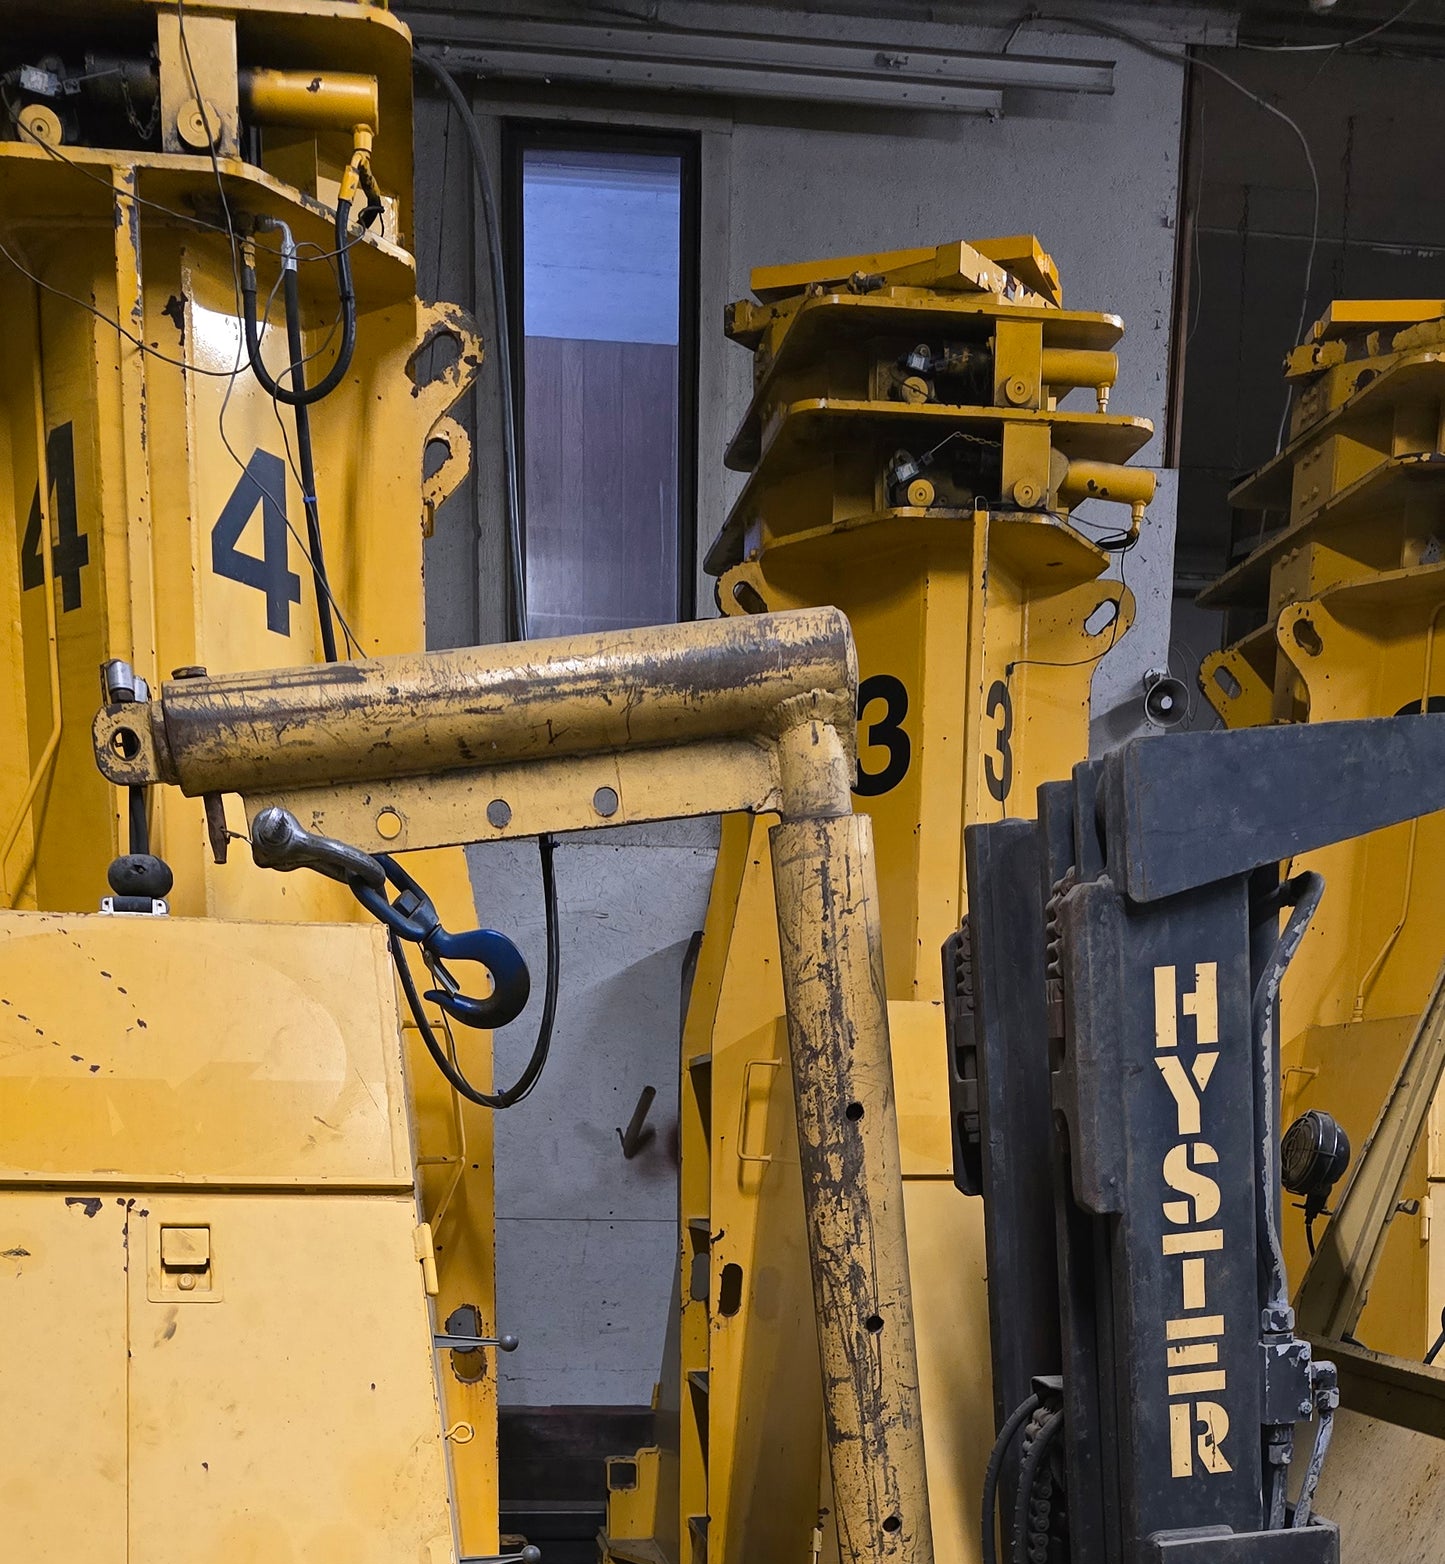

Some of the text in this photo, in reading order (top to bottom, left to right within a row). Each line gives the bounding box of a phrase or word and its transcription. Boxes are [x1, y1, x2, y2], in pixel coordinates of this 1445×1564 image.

[21, 420, 89, 613] 4
[211, 447, 301, 637] 4
[850, 674, 911, 796] 3
[984, 680, 1013, 801] 3
[1154, 962, 1233, 1478] HYSTER
